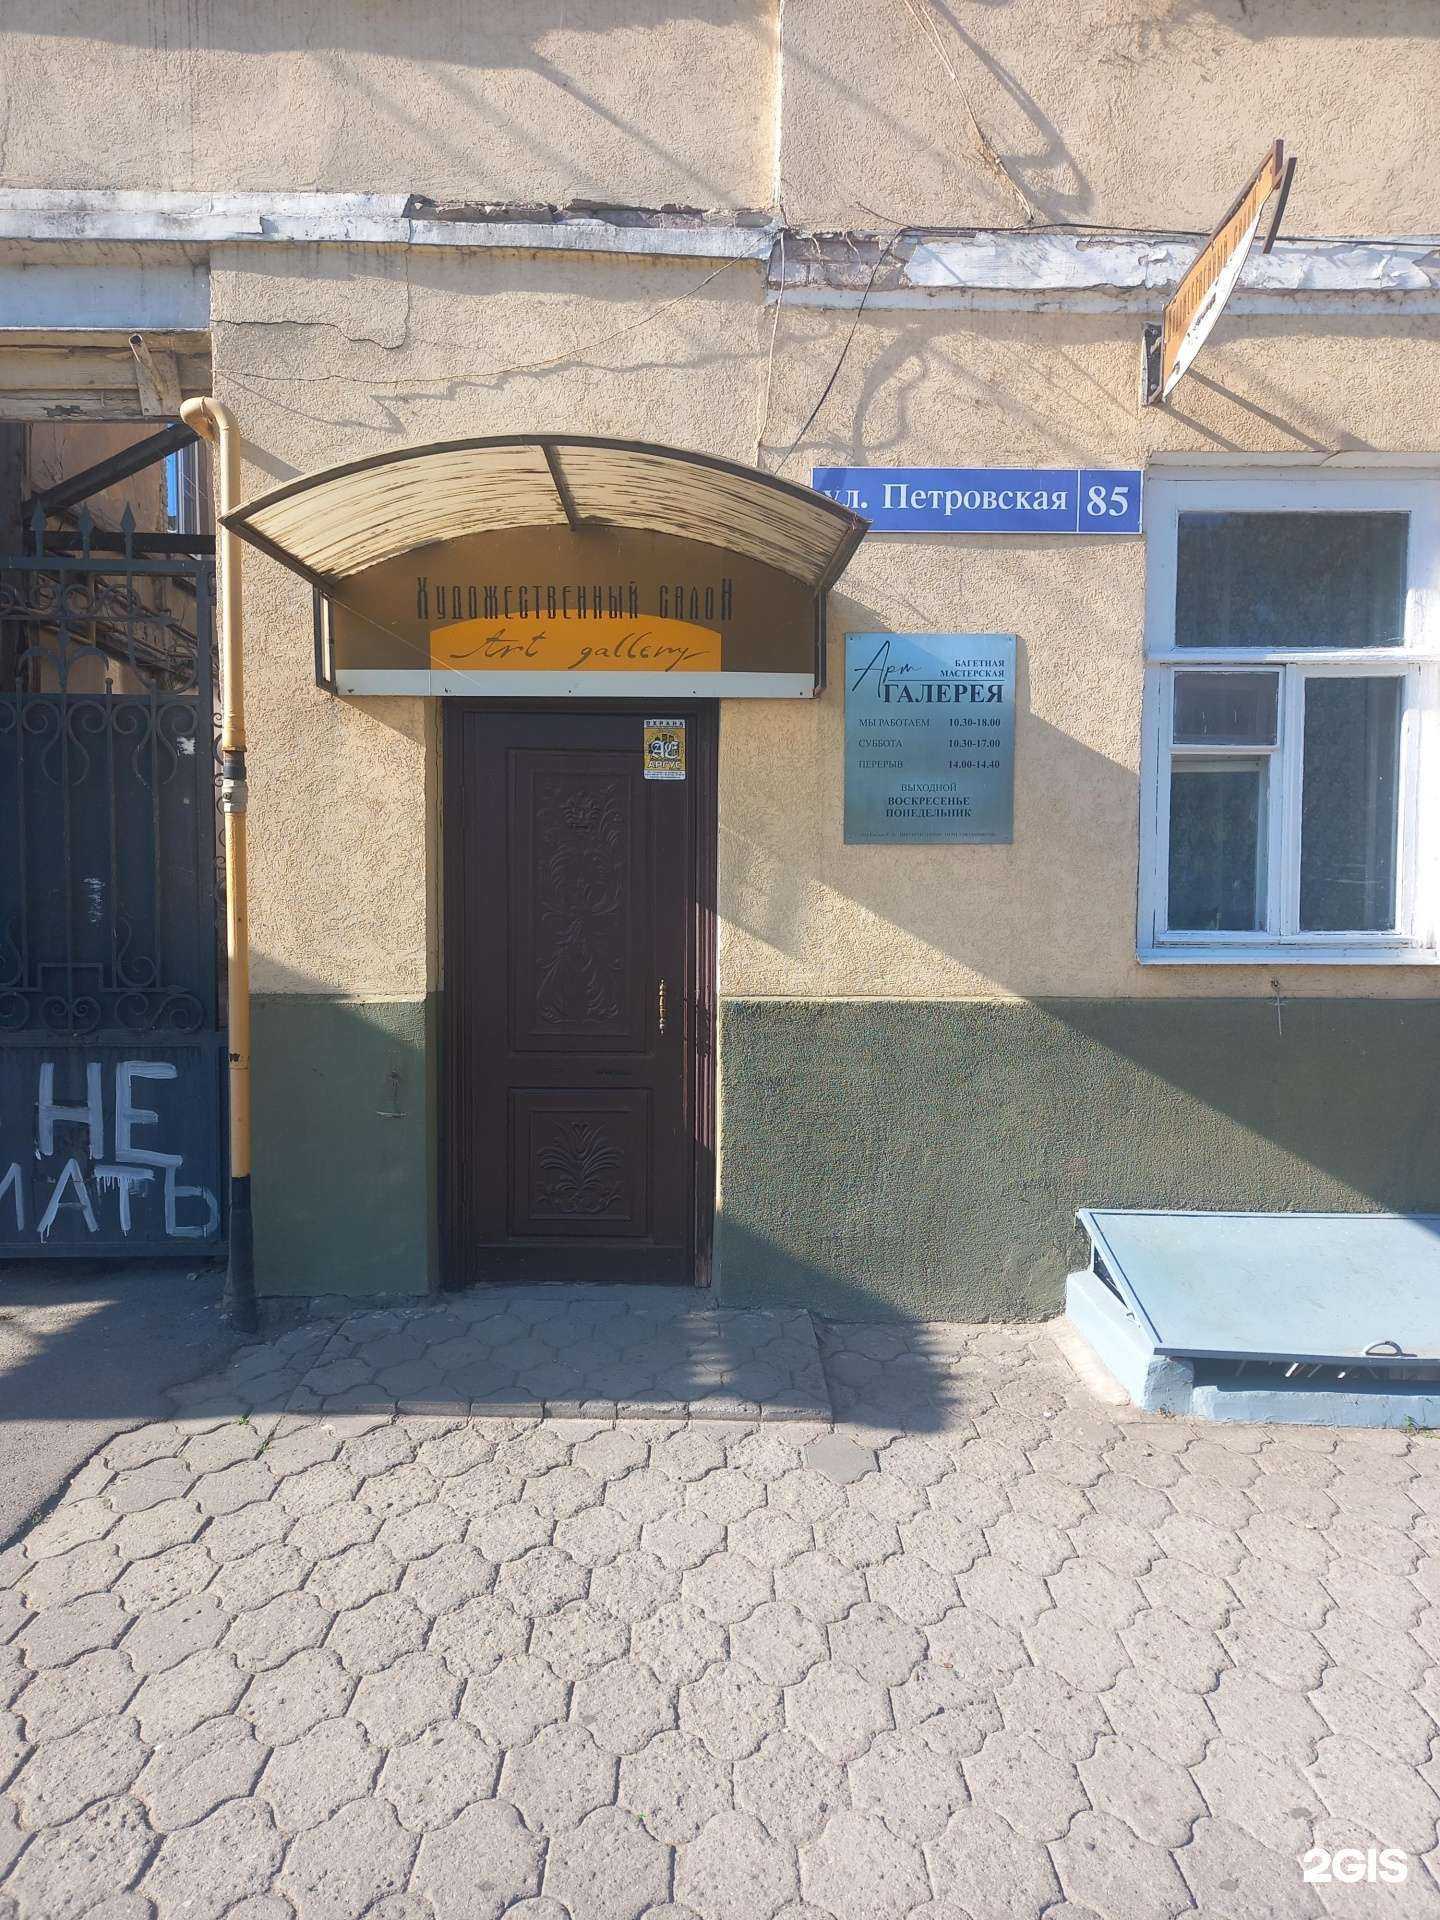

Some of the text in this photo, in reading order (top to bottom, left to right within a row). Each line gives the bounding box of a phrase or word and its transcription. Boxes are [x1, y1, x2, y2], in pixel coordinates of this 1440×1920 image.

[882, 484, 1068, 516] Петровская
[1086, 486, 1129, 516] 85
[450, 628, 710, 672] Art gallery
[955, 659, 1005, 668] БАГЕТНАЯ
[852, 640, 922, 698] Арт
[940, 669, 1005, 678] МАСТЕРСКАЯ
[883, 684, 1003, 703] ГАЛЕРЕЯ
[859, 718, 930, 727] МЫ РАБОТАЕМ
[949, 718, 1001, 728] 10.30-18.00
[858, 739, 903, 748] СУББОТА
[949, 739, 1001, 748] 10.30-17.00
[648, 760, 681, 769] АРГУС
[858, 760, 904, 769] ПЕРЕРЫВ
[948, 760, 1000, 769] 14.00-14.40
[901, 783, 957, 792] ВЫХОДНОЙ
[887, 796, 970, 806] ВОСКРЕСЕНЬЕ
[886, 808, 972, 818] ПОНЕДЕЛЬНИК
[36, 1061, 183, 1168] НЕ
